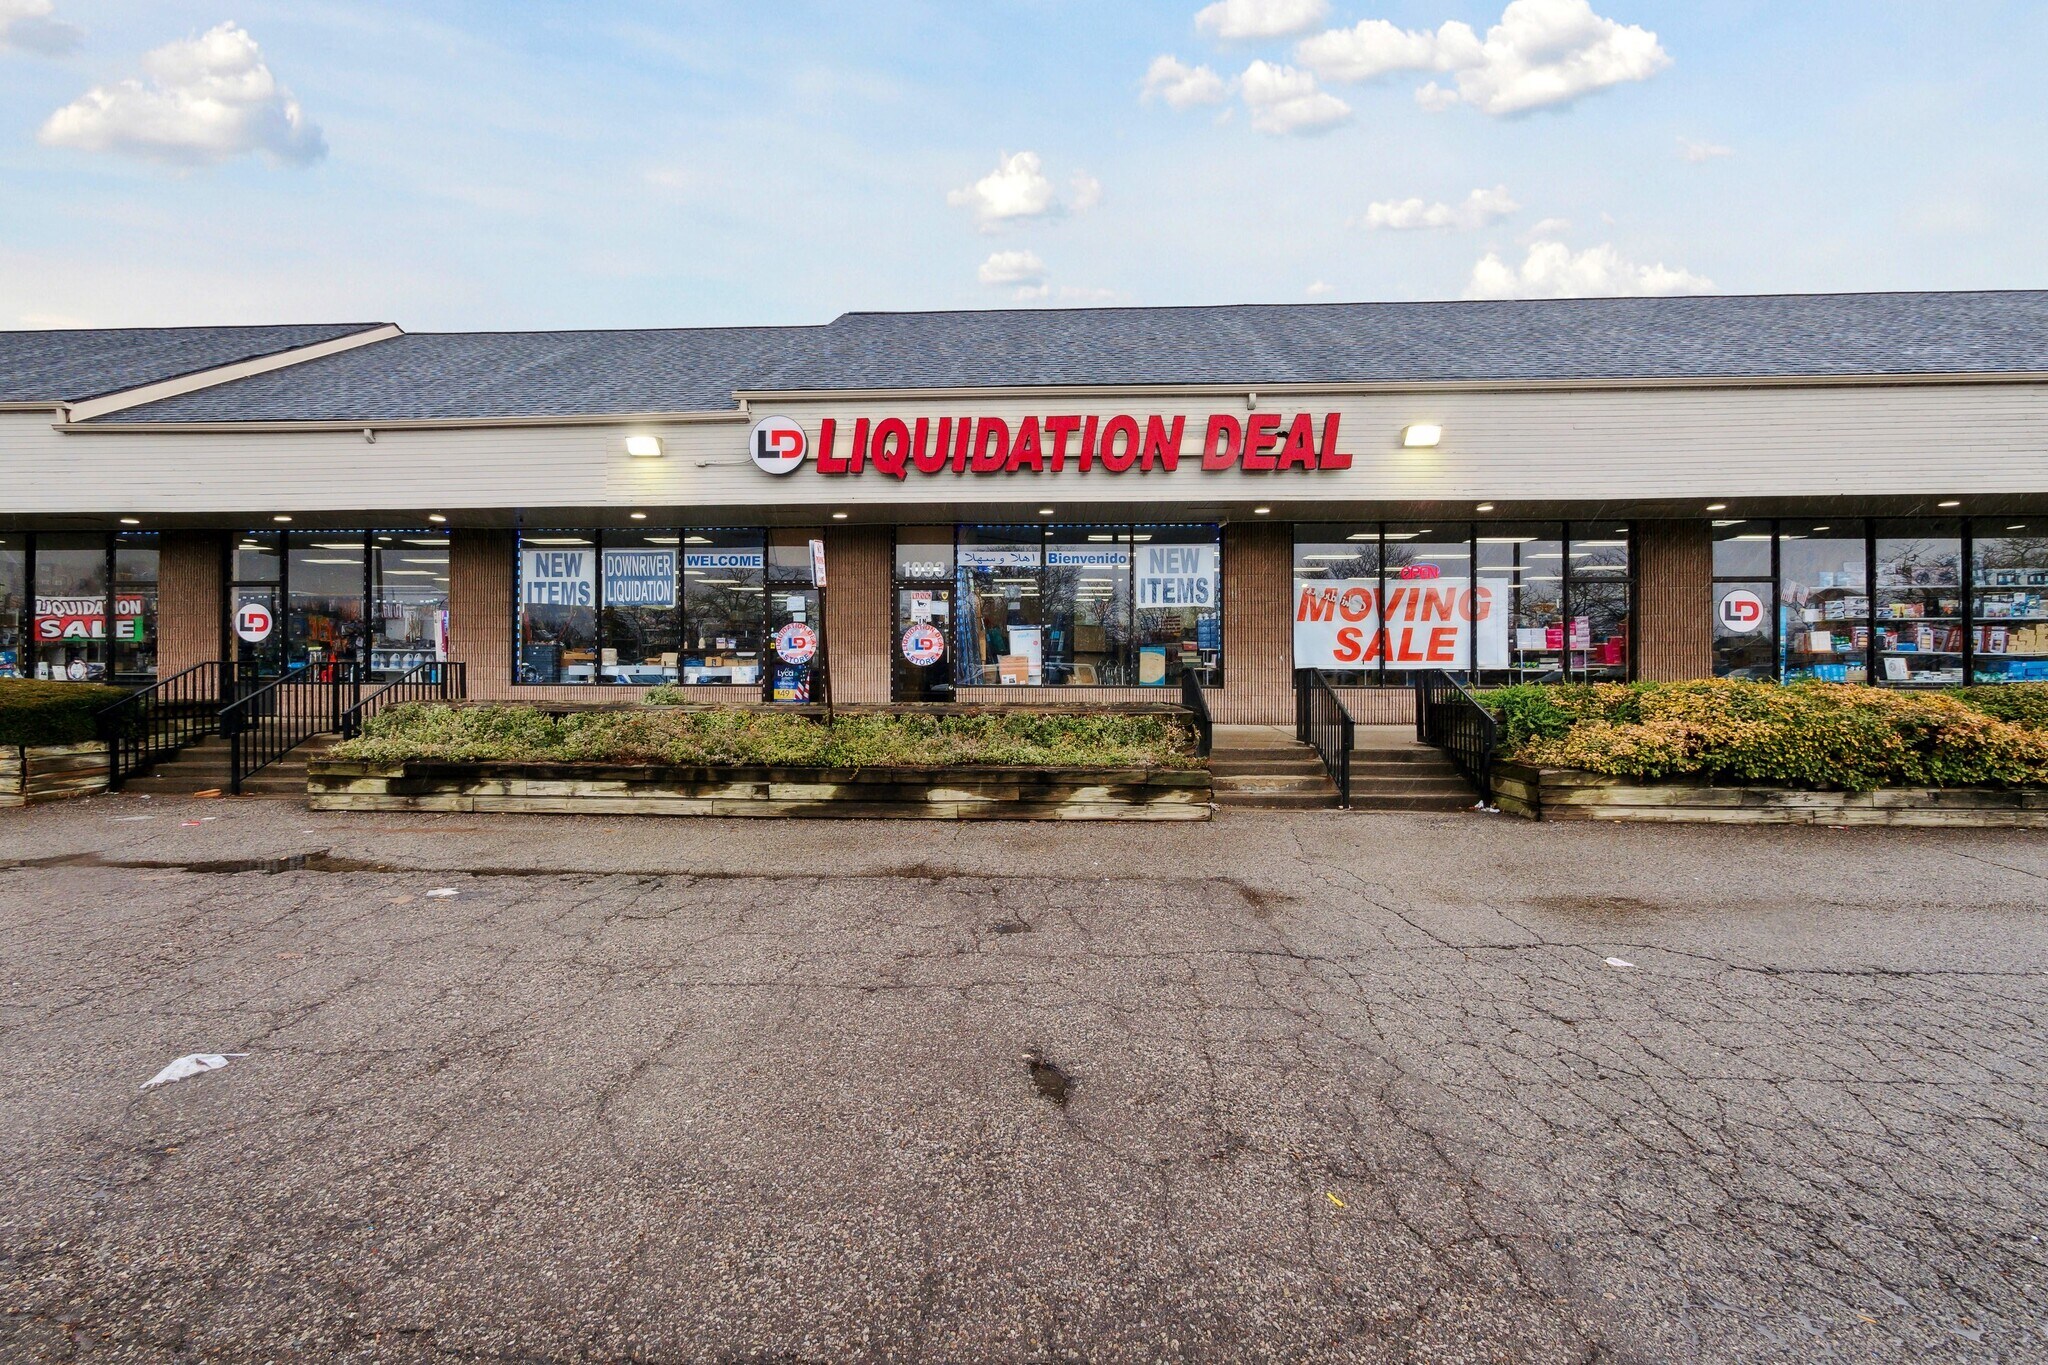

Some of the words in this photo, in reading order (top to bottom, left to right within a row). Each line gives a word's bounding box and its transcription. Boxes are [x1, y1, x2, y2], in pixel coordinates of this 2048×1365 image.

[758, 430, 803, 459] LD
[816, 415, 1186, 482] LIQUIDATION
[1201, 413, 1353, 471] DEAL
[536, 553, 583, 578] NEW
[607, 555, 671, 577] DOWNRIVER
[687, 555, 761, 567] WELCOME
[1048, 552, 1127, 564] Bienvenido
[1149, 548, 1200, 574] NEW
[902, 561, 946, 578] 1093
[1401, 566, 1440, 580] OPEN
[527, 580, 591, 606] ITEMS
[607, 579, 671, 603] LIQUIDATION
[1140, 577, 1209, 604] ITEMS
[35, 599, 141, 618] LIQUIDAION
[1296, 586, 1493, 622] MOVING
[1724, 601, 1759, 621] LD
[40, 619, 135, 639] SALE
[240, 613, 269, 632] LD
[776, 622, 807, 650] LIQUIDATION
[788, 637, 807, 649] LD
[902, 624, 935, 651] LIQUIDATION
[914, 638, 933, 650] LD
[1333, 627, 1458, 662] SALE
[783, 654, 810, 664] STORE
[909, 655, 936, 666] STORE
